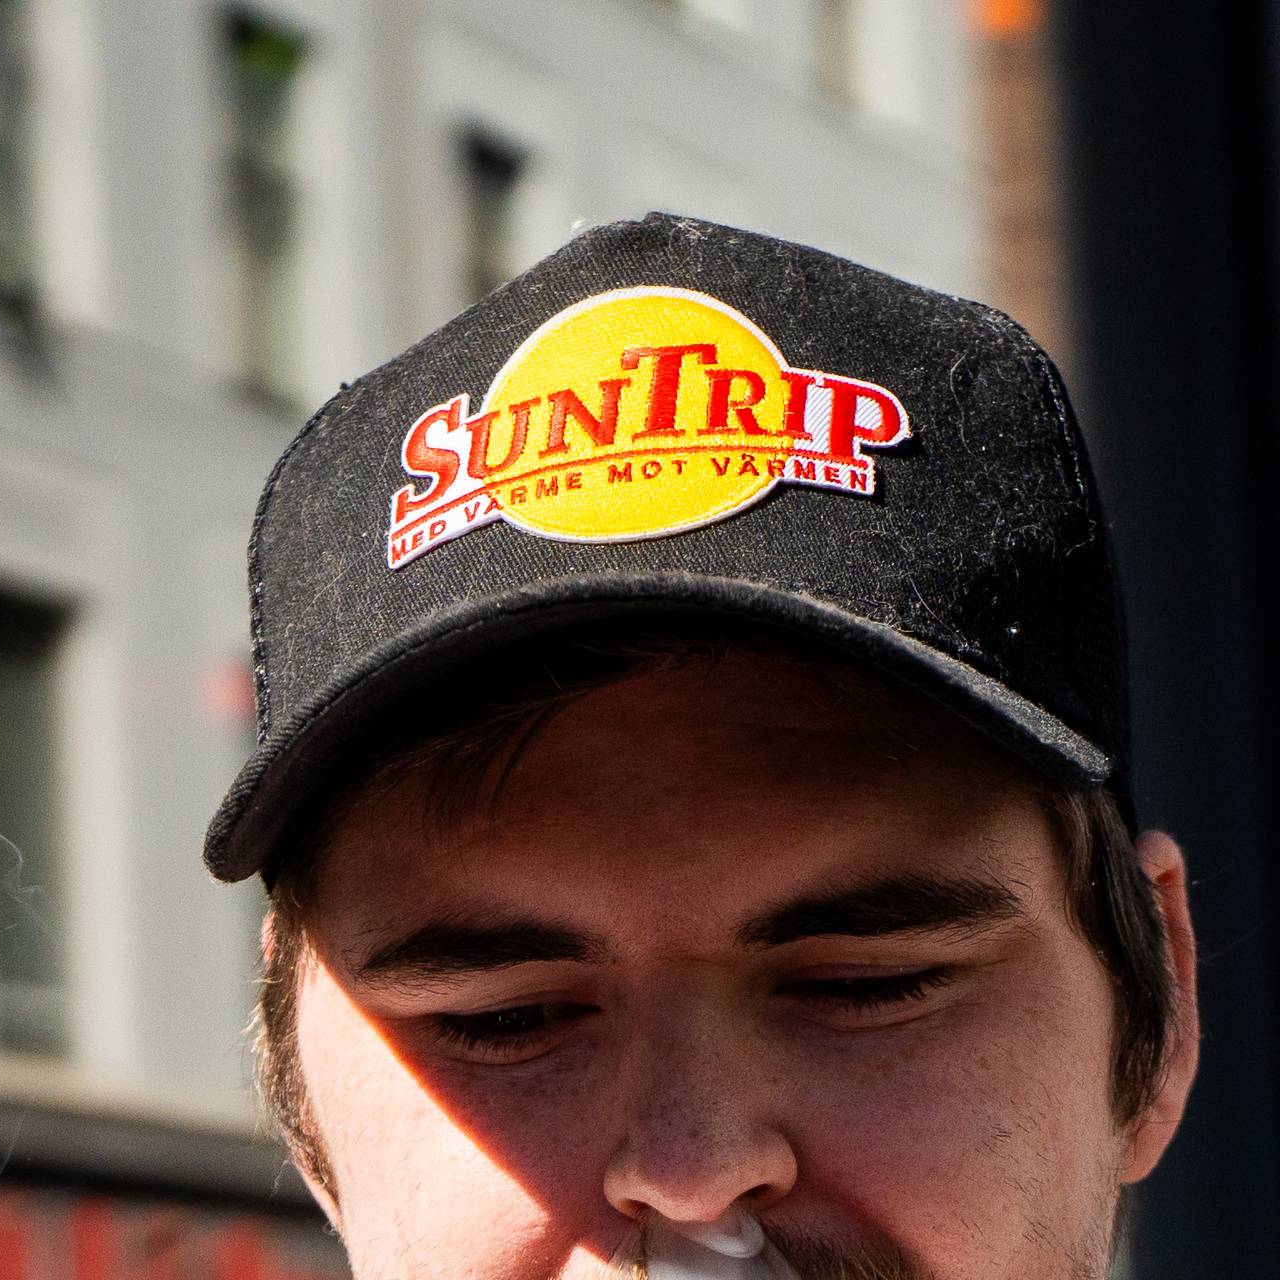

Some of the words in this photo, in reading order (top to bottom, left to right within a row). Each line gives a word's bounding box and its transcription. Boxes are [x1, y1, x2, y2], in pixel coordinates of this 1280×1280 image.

[391, 519, 447, 565] MED
[463, 471, 583, 523] VÄRME
[607, 460, 687, 484] MOT
[710, 453, 868, 492] VÄRMEN
